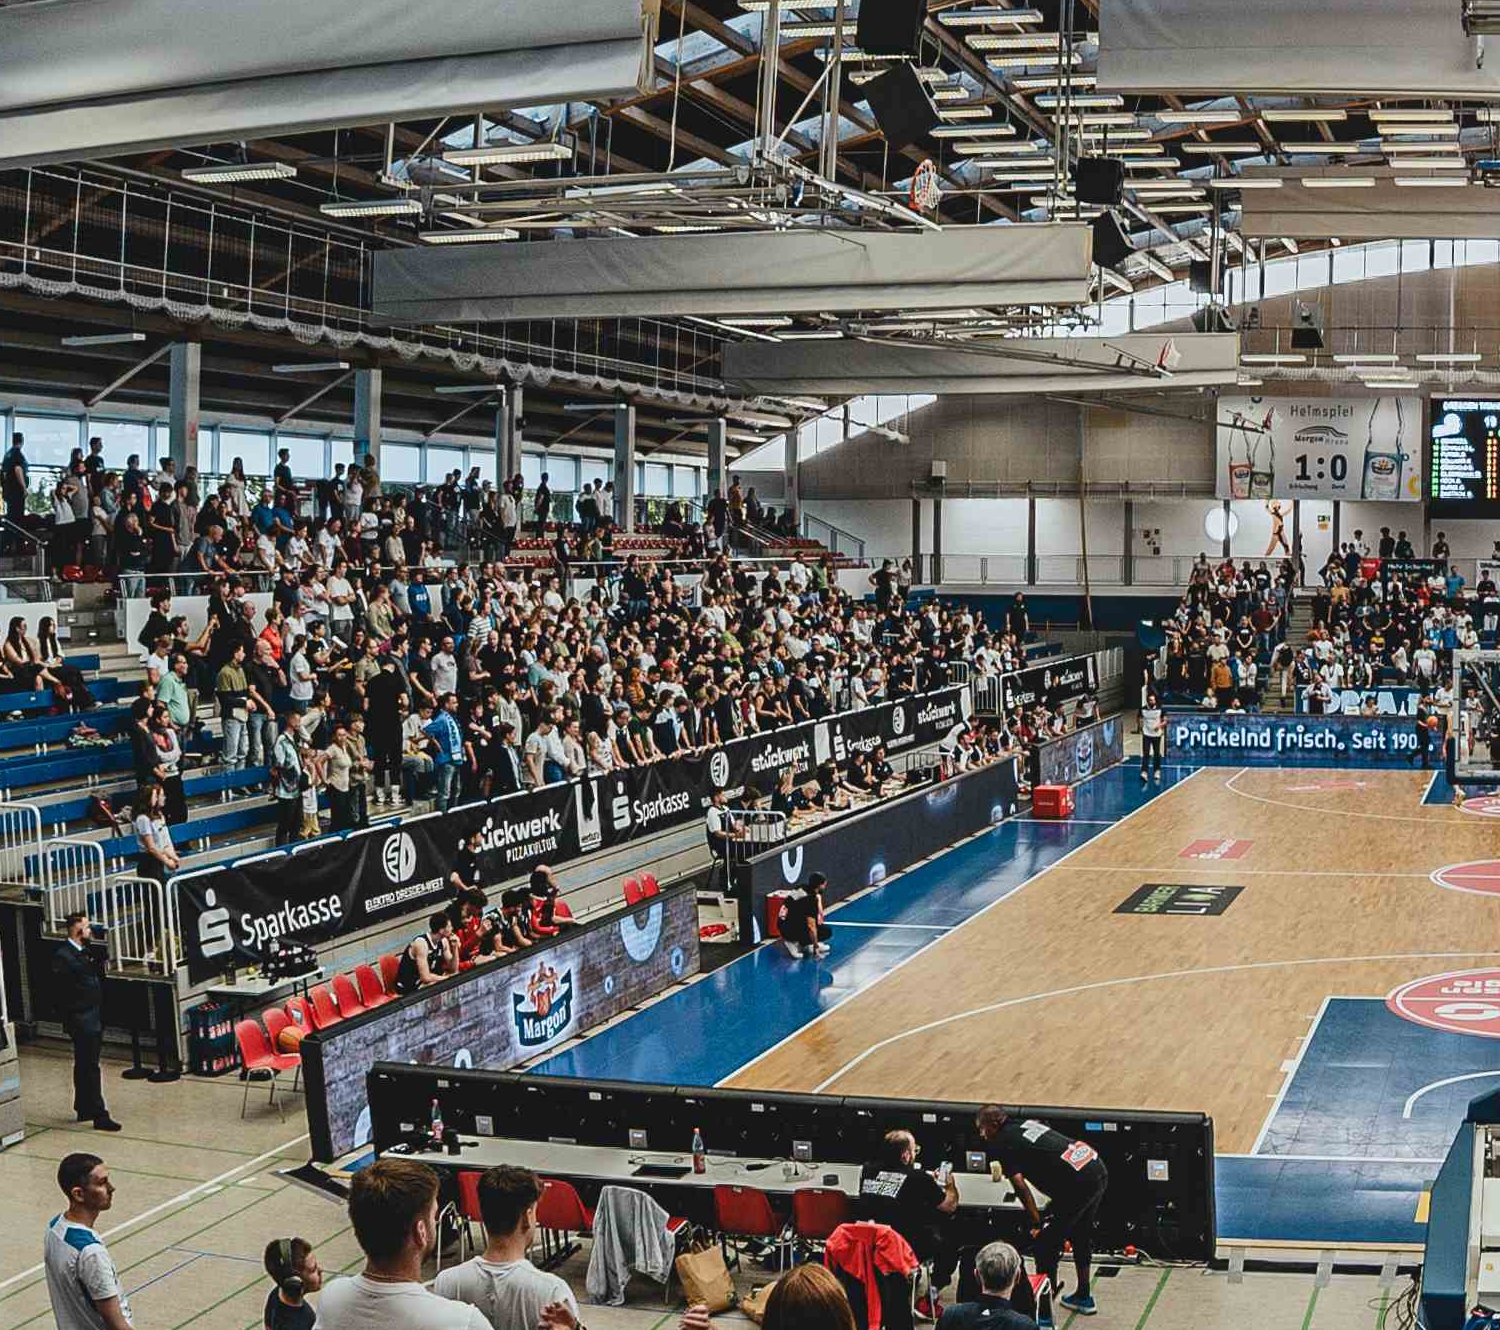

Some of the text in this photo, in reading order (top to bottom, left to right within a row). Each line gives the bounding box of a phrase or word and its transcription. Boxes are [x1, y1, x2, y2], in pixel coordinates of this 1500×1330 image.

[1290, 405, 1353, 419] Heimspiel
[1295, 453, 1347, 481] 1:0
[1176, 723, 1271, 748] Prickelnd
[1276, 724, 1345, 752] frisch.
[1352, 730, 1386, 749] Seit
[633, 790, 690, 826] Sparkasse
[506, 837, 557, 863] PIZZAKULTUR
[241, 893, 343, 950] Sparkasse
[523, 1006, 567, 1039] Margon
